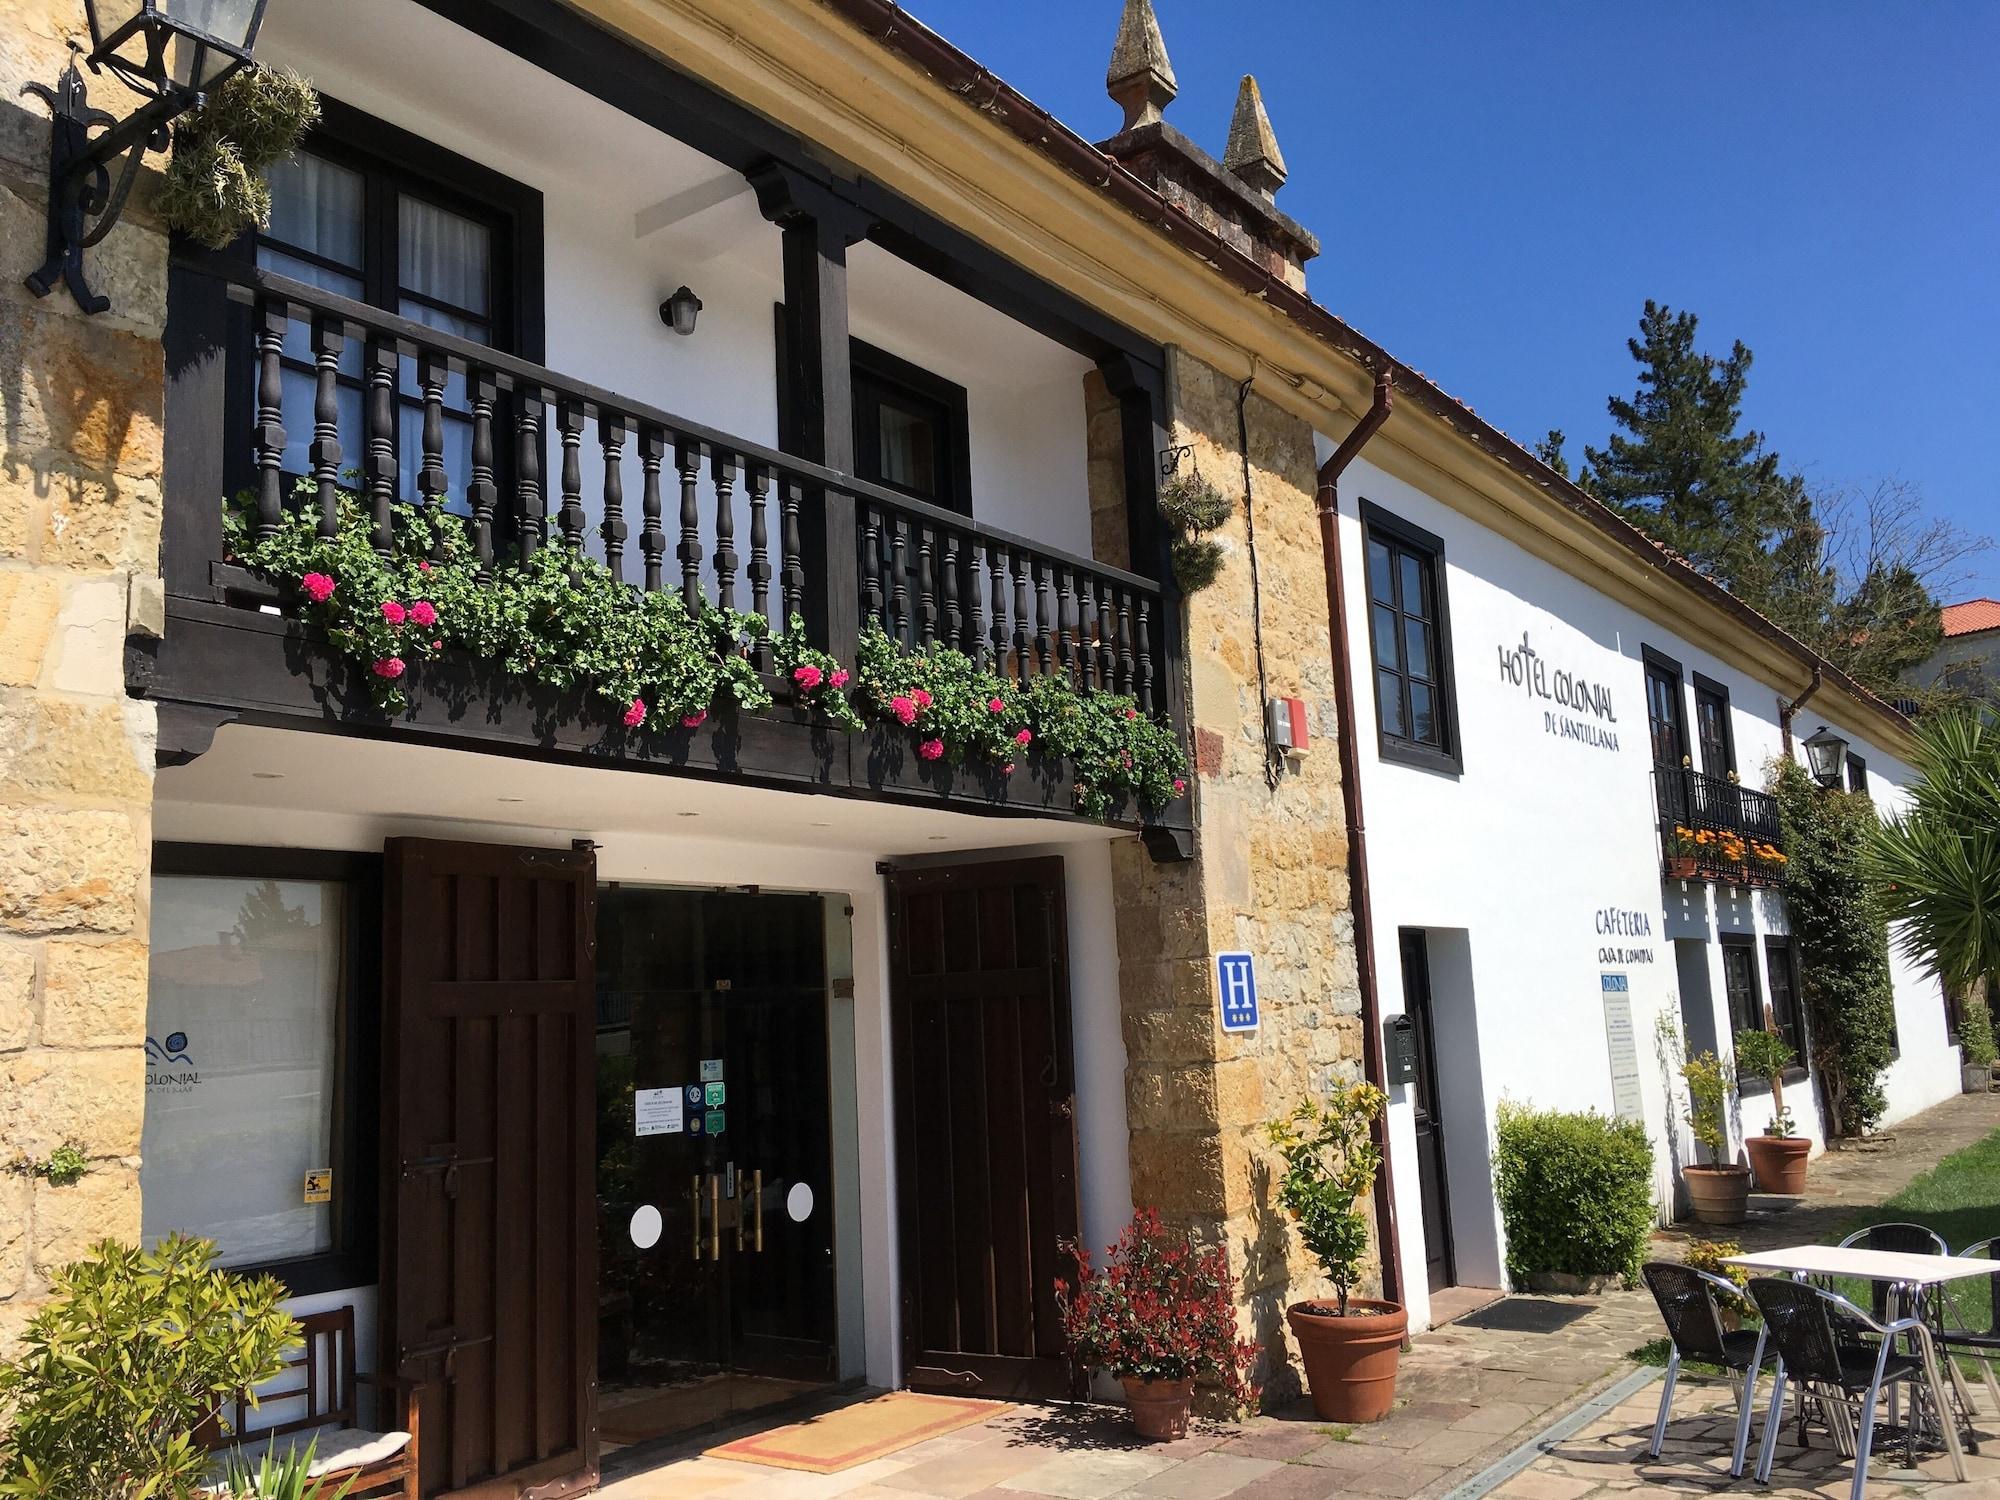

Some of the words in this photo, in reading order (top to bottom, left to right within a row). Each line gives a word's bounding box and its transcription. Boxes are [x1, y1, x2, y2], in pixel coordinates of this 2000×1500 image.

[1498, 630, 1552, 699] HOTEL
[1554, 669, 1617, 723] COLONIAL
[1544, 711, 1557, 735] DE
[1560, 715, 1620, 752] SANTILLANA
[1596, 907, 1651, 936] CAFETERIA
[1223, 962, 1253, 1009] H
